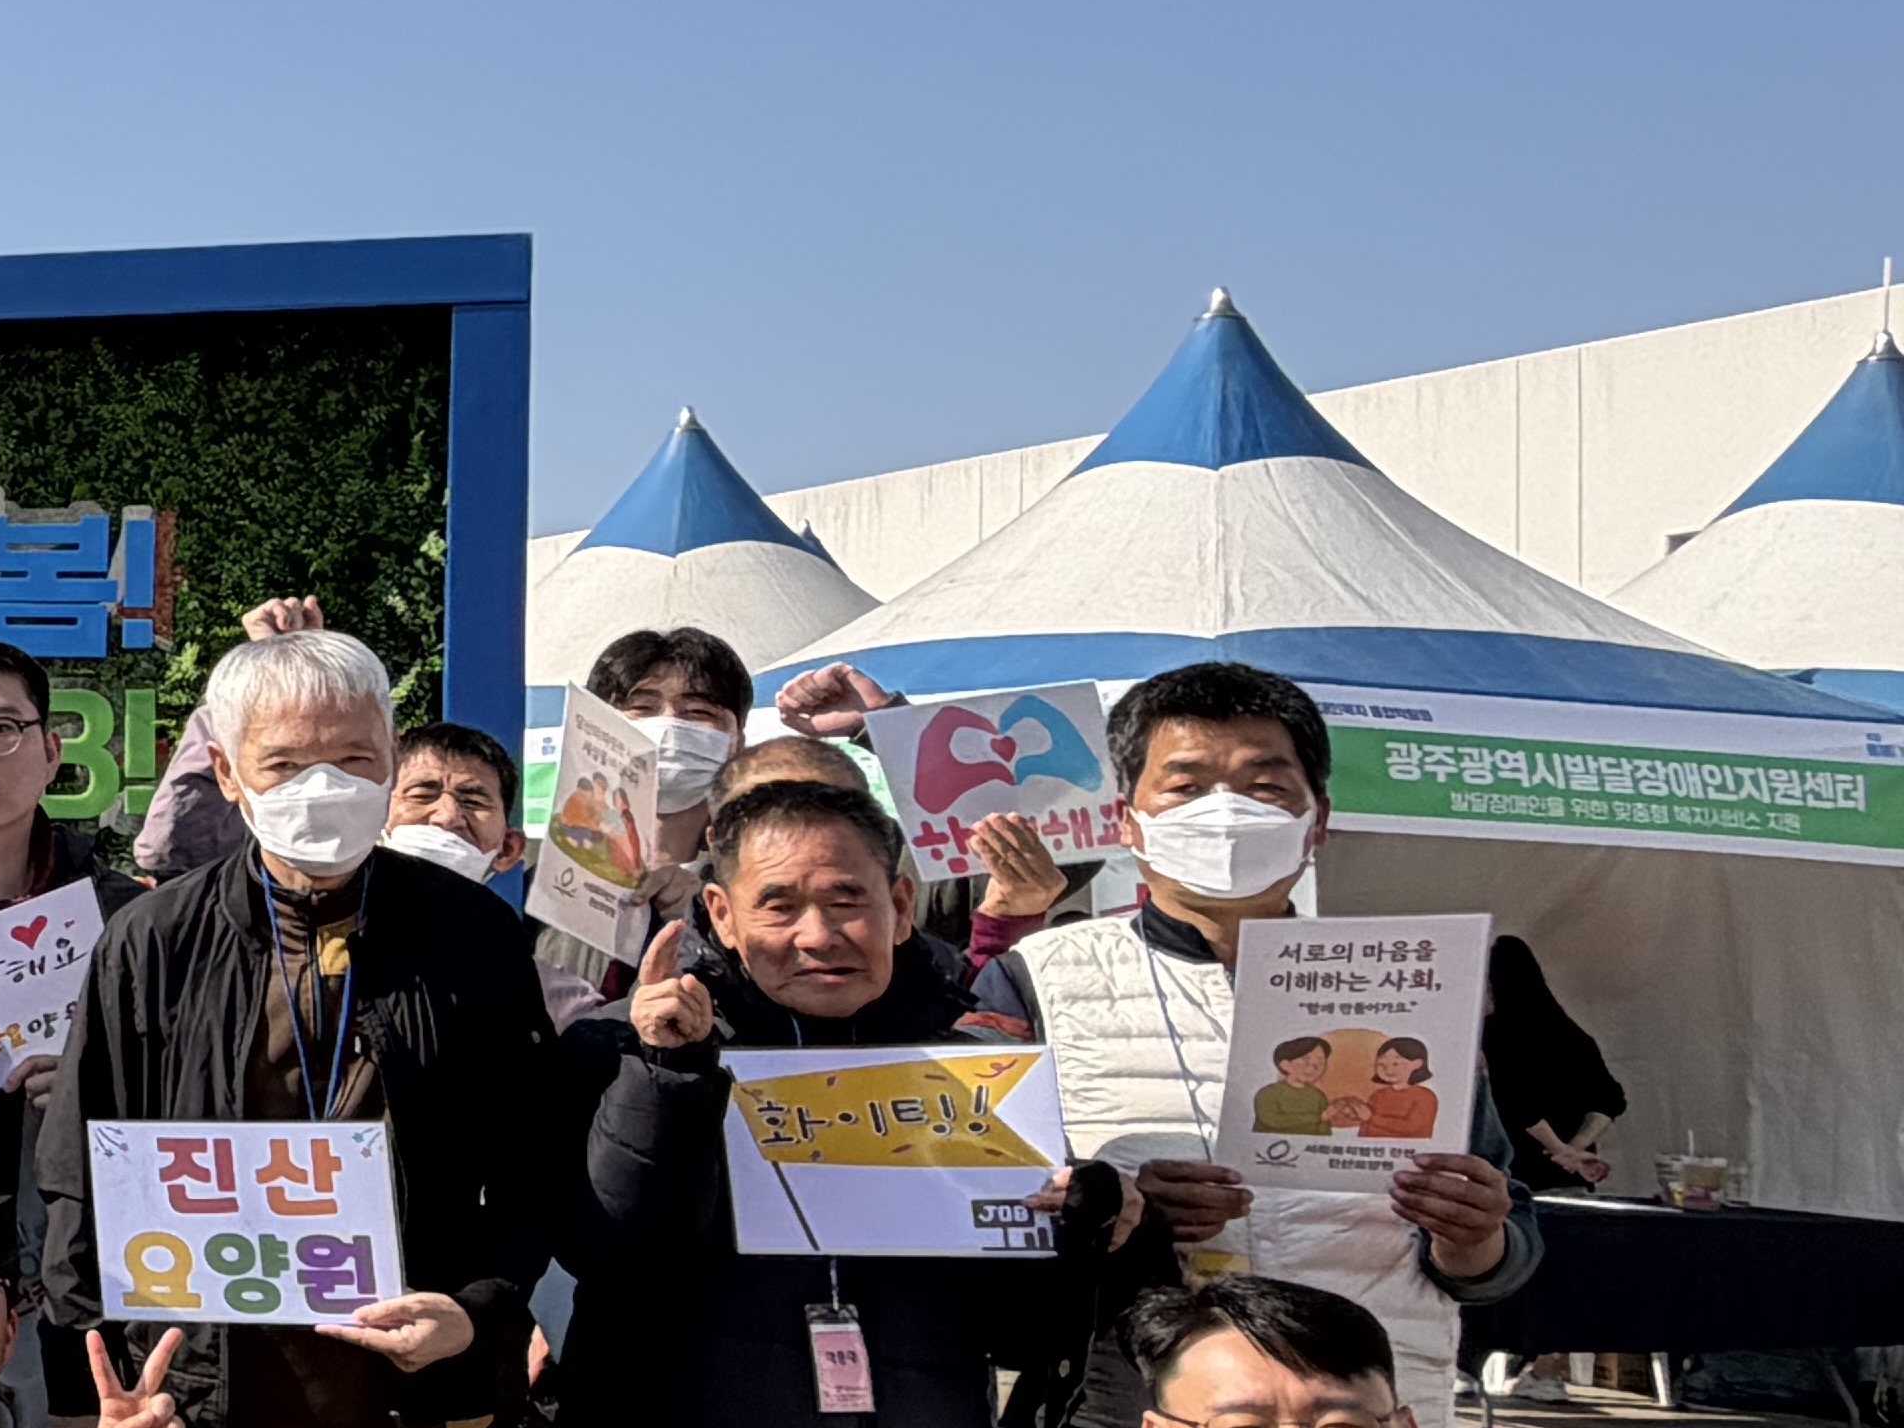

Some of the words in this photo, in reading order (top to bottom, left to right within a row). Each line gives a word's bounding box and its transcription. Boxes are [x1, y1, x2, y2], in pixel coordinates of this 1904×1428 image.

[1384, 740, 1867, 813] 광주광역시발달장애인지원센터
[1269, 970, 1373, 993] 이해하는
[1378, 968, 1442, 993] 사회,
[1277, 941, 1354, 964] 서로의
[1362, 940, 1438, 963] 마음을
[156, 1137, 343, 1217] 진산
[122, 1231, 380, 1315] 요양원
